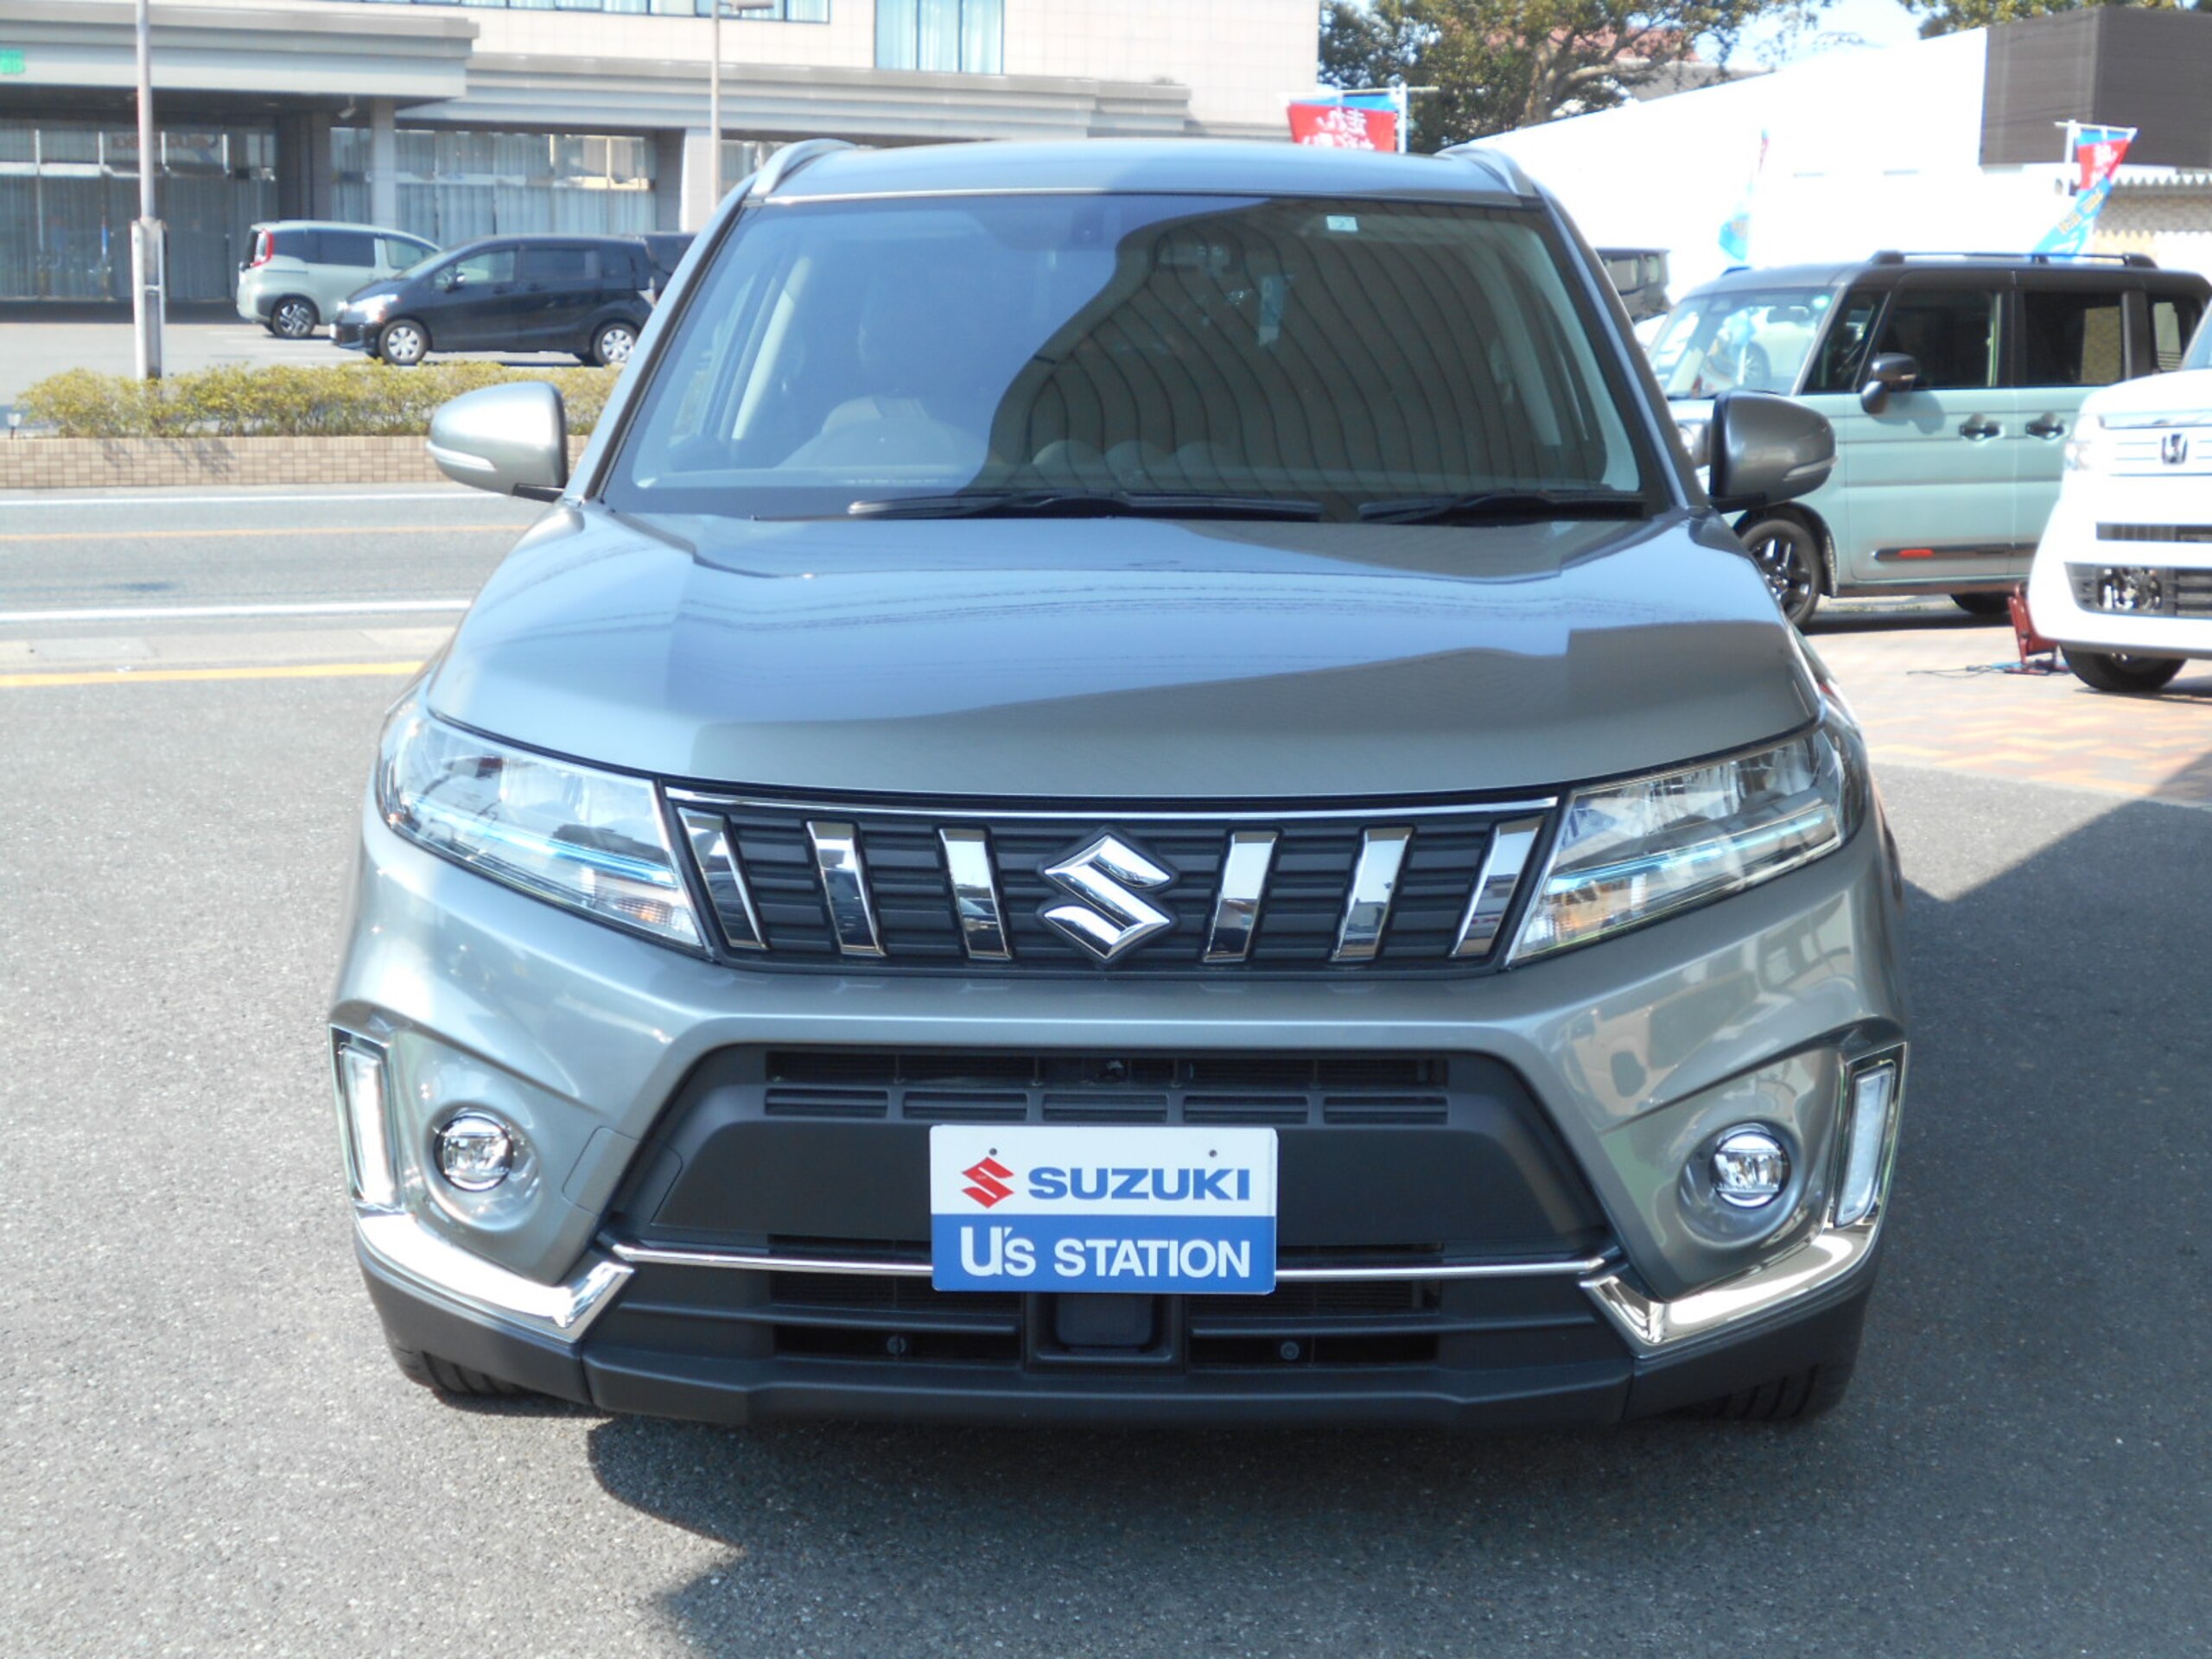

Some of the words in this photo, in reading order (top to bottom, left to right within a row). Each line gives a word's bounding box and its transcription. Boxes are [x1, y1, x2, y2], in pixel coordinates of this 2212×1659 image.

[1027, 1166, 1250, 1201] SUZUKI
[960, 1226, 1036, 1277] U's
[1053, 1238, 1250, 1278] STATION
